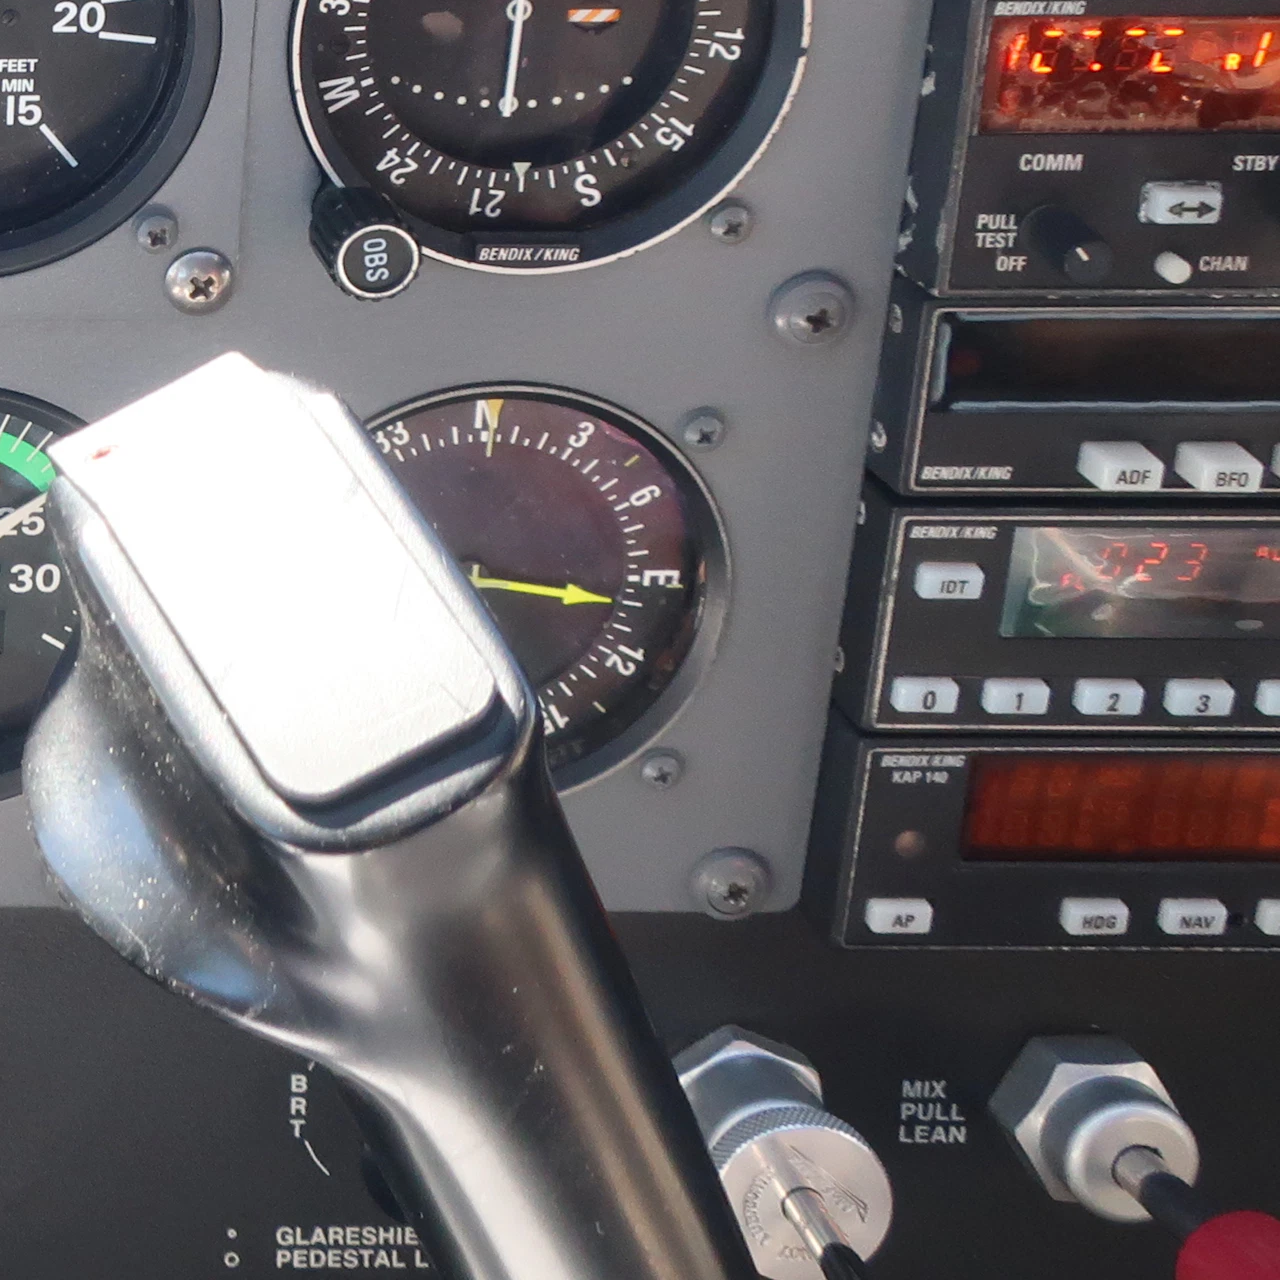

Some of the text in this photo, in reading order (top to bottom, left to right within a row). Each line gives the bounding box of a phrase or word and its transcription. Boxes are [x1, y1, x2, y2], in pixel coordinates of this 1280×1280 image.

[53, 2, 105, 33] 20
[2, 79, 34, 92] MIN
[1020, 154, 1083, 171] COMM
[363, 238, 389, 281] OBS
[479, 248, 579, 261] BENDIX/KING
[1199, 256, 1248, 271] CHAN
[1116, 470, 1151, 485] ADF
[1216, 472, 1248, 487] BFO
[9, 564, 60, 592] 30
[903, 1080, 946, 1098] MIX
[901, 1103, 965, 1121] PULL
[899, 1125, 966, 1143] LEAN
[276, 1249, 405, 1268] PEDESTAL
